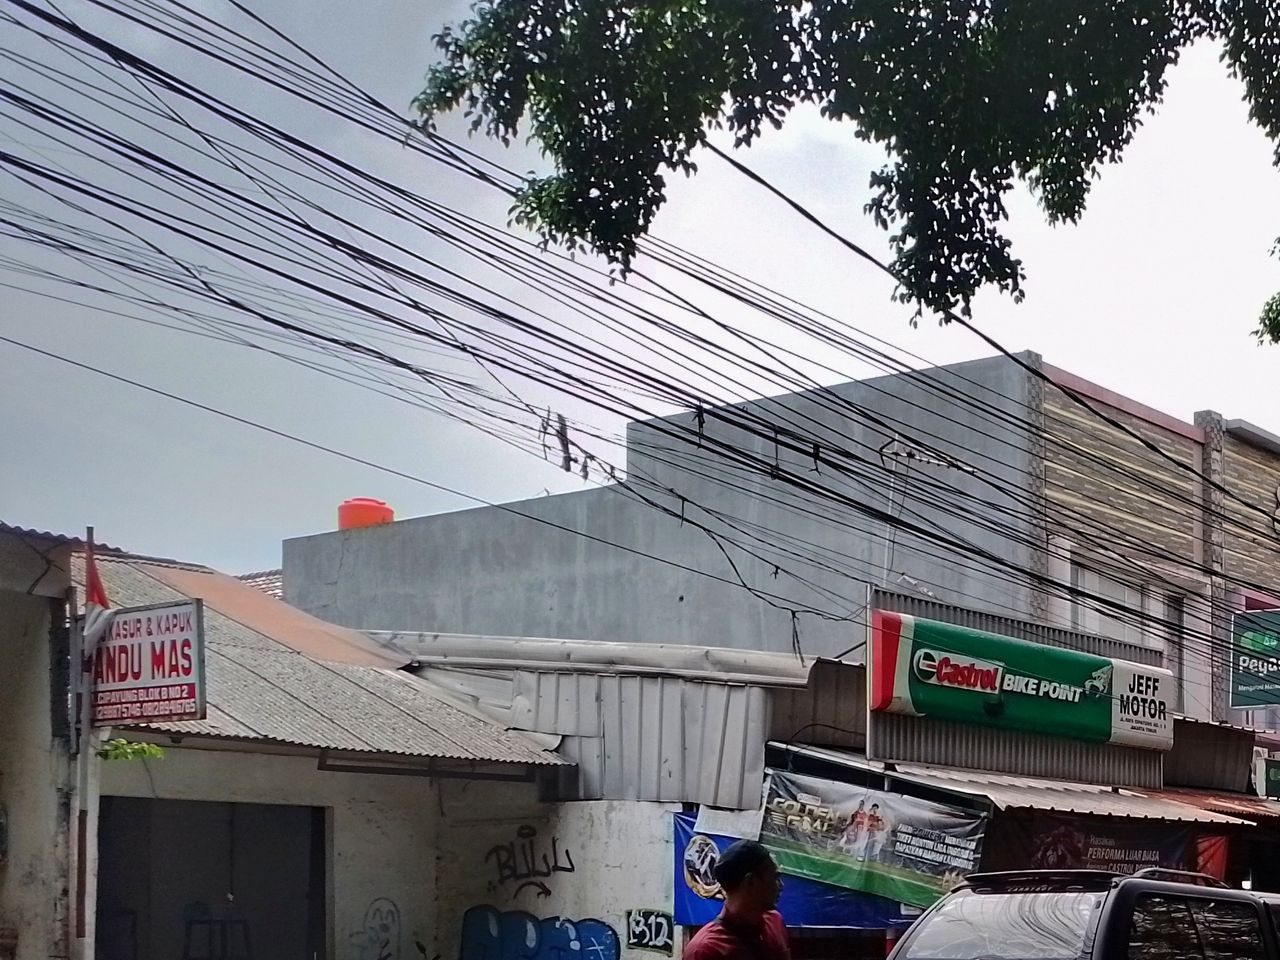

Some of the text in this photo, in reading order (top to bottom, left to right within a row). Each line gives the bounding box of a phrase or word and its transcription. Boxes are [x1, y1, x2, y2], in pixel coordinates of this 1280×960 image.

[146, 617, 153, 636] &
[157, 611, 192, 635] KAPUK
[94, 638, 192, 684] ANDU MAS
[936, 656, 1083, 703] Castrol BIKE POINT
[1129, 673, 1160, 697] JEFF
[1120, 694, 1166, 721] MOTOR
[1088, 847, 1125, 861] PERFORMA
